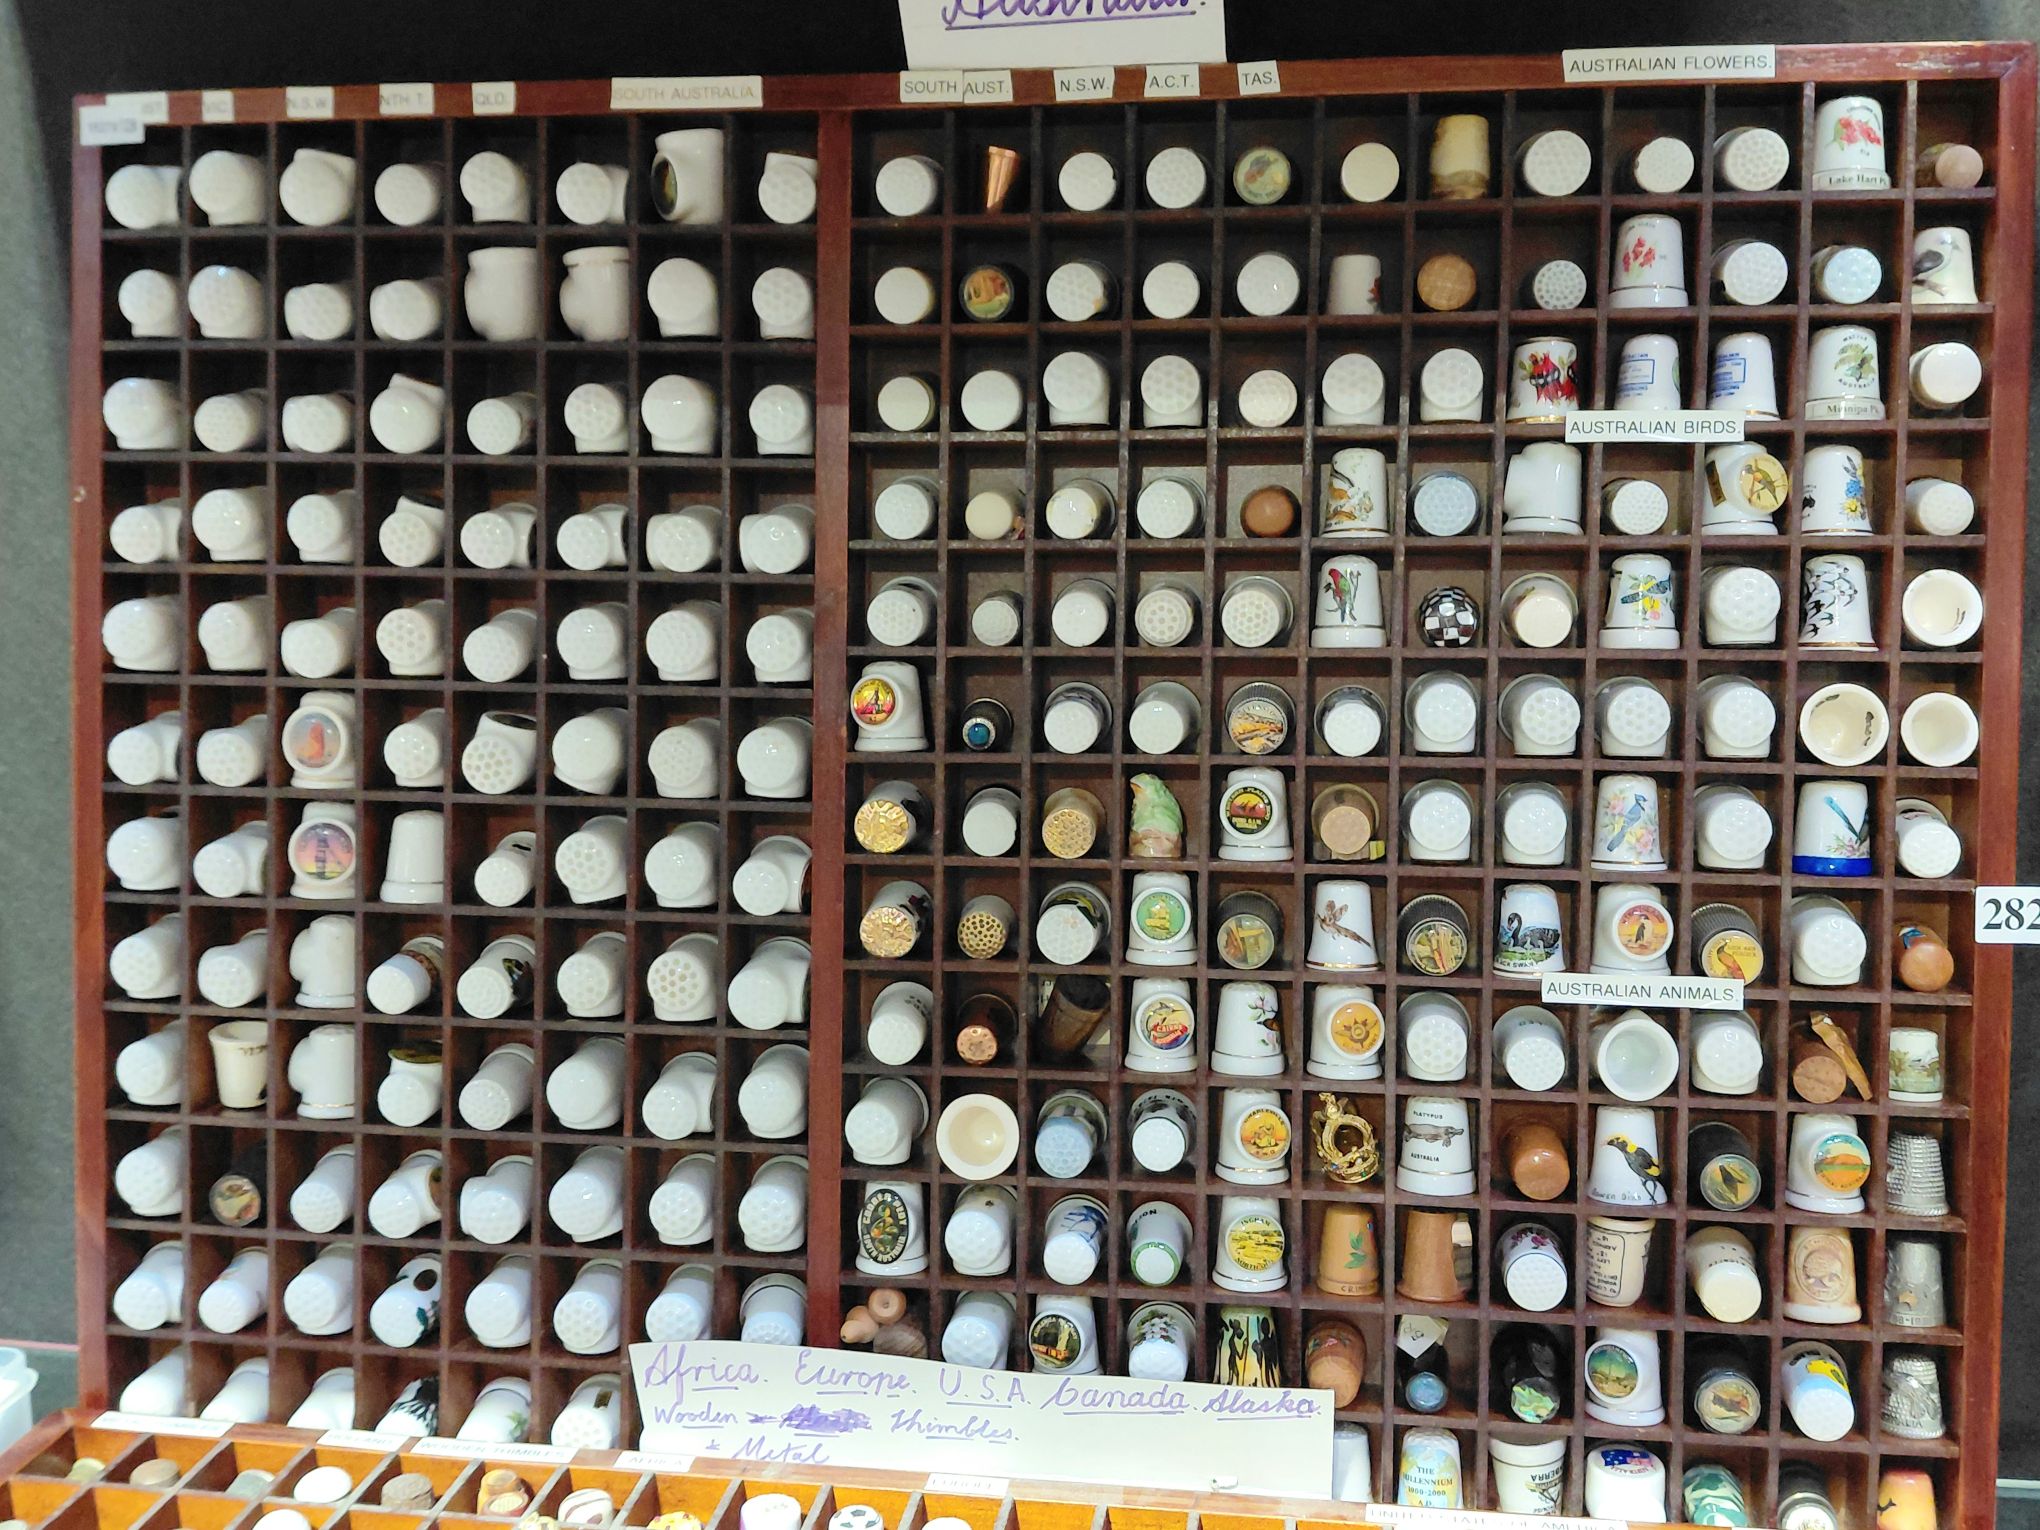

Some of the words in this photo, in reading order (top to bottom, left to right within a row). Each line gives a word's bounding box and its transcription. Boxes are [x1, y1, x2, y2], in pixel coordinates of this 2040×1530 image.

[1569, 57, 1677, 73] AUSTRALIAN
[1683, 55, 1773, 71] FLOWERS.
[904, 80, 957, 95] SOUTH
[964, 78, 1010, 95] AUST.
[1060, 77, 1110, 93] N.S.W.
[1149, 74, 1195, 89] A.C.T.
[1242, 70, 1277, 87] TAS.
[614, 88, 665, 102] SOUTH
[1569, 420, 1676, 435] AUSTRALIAN
[1683, 420, 1742, 435] BIRDS.
[1983, 897, 2040, 931] 282
[1546, 981, 1652, 999] AUSTRALIAN
[1658, 985, 1740, 1003] ANIMALS.
[1413, 1110, 1443, 1120] PLATYPUS
[1410, 1152, 1440, 1163] AUSTRALIA
[645, 1343, 769, 1406] Africa.
[794, 1348, 917, 1396] Europe.
[939, 1366, 1032, 1405] U.S.A.
[1039, 1376, 1198, 1411] Canada.
[1201, 1387, 1322, 1416] Alaska.
[655, 1401, 738, 1426] Wooden
[889, 1408, 1020, 1441] Thimbles.
[729, 1434, 832, 1465] Metal
[1416, 1465, 1435, 1475] THE
